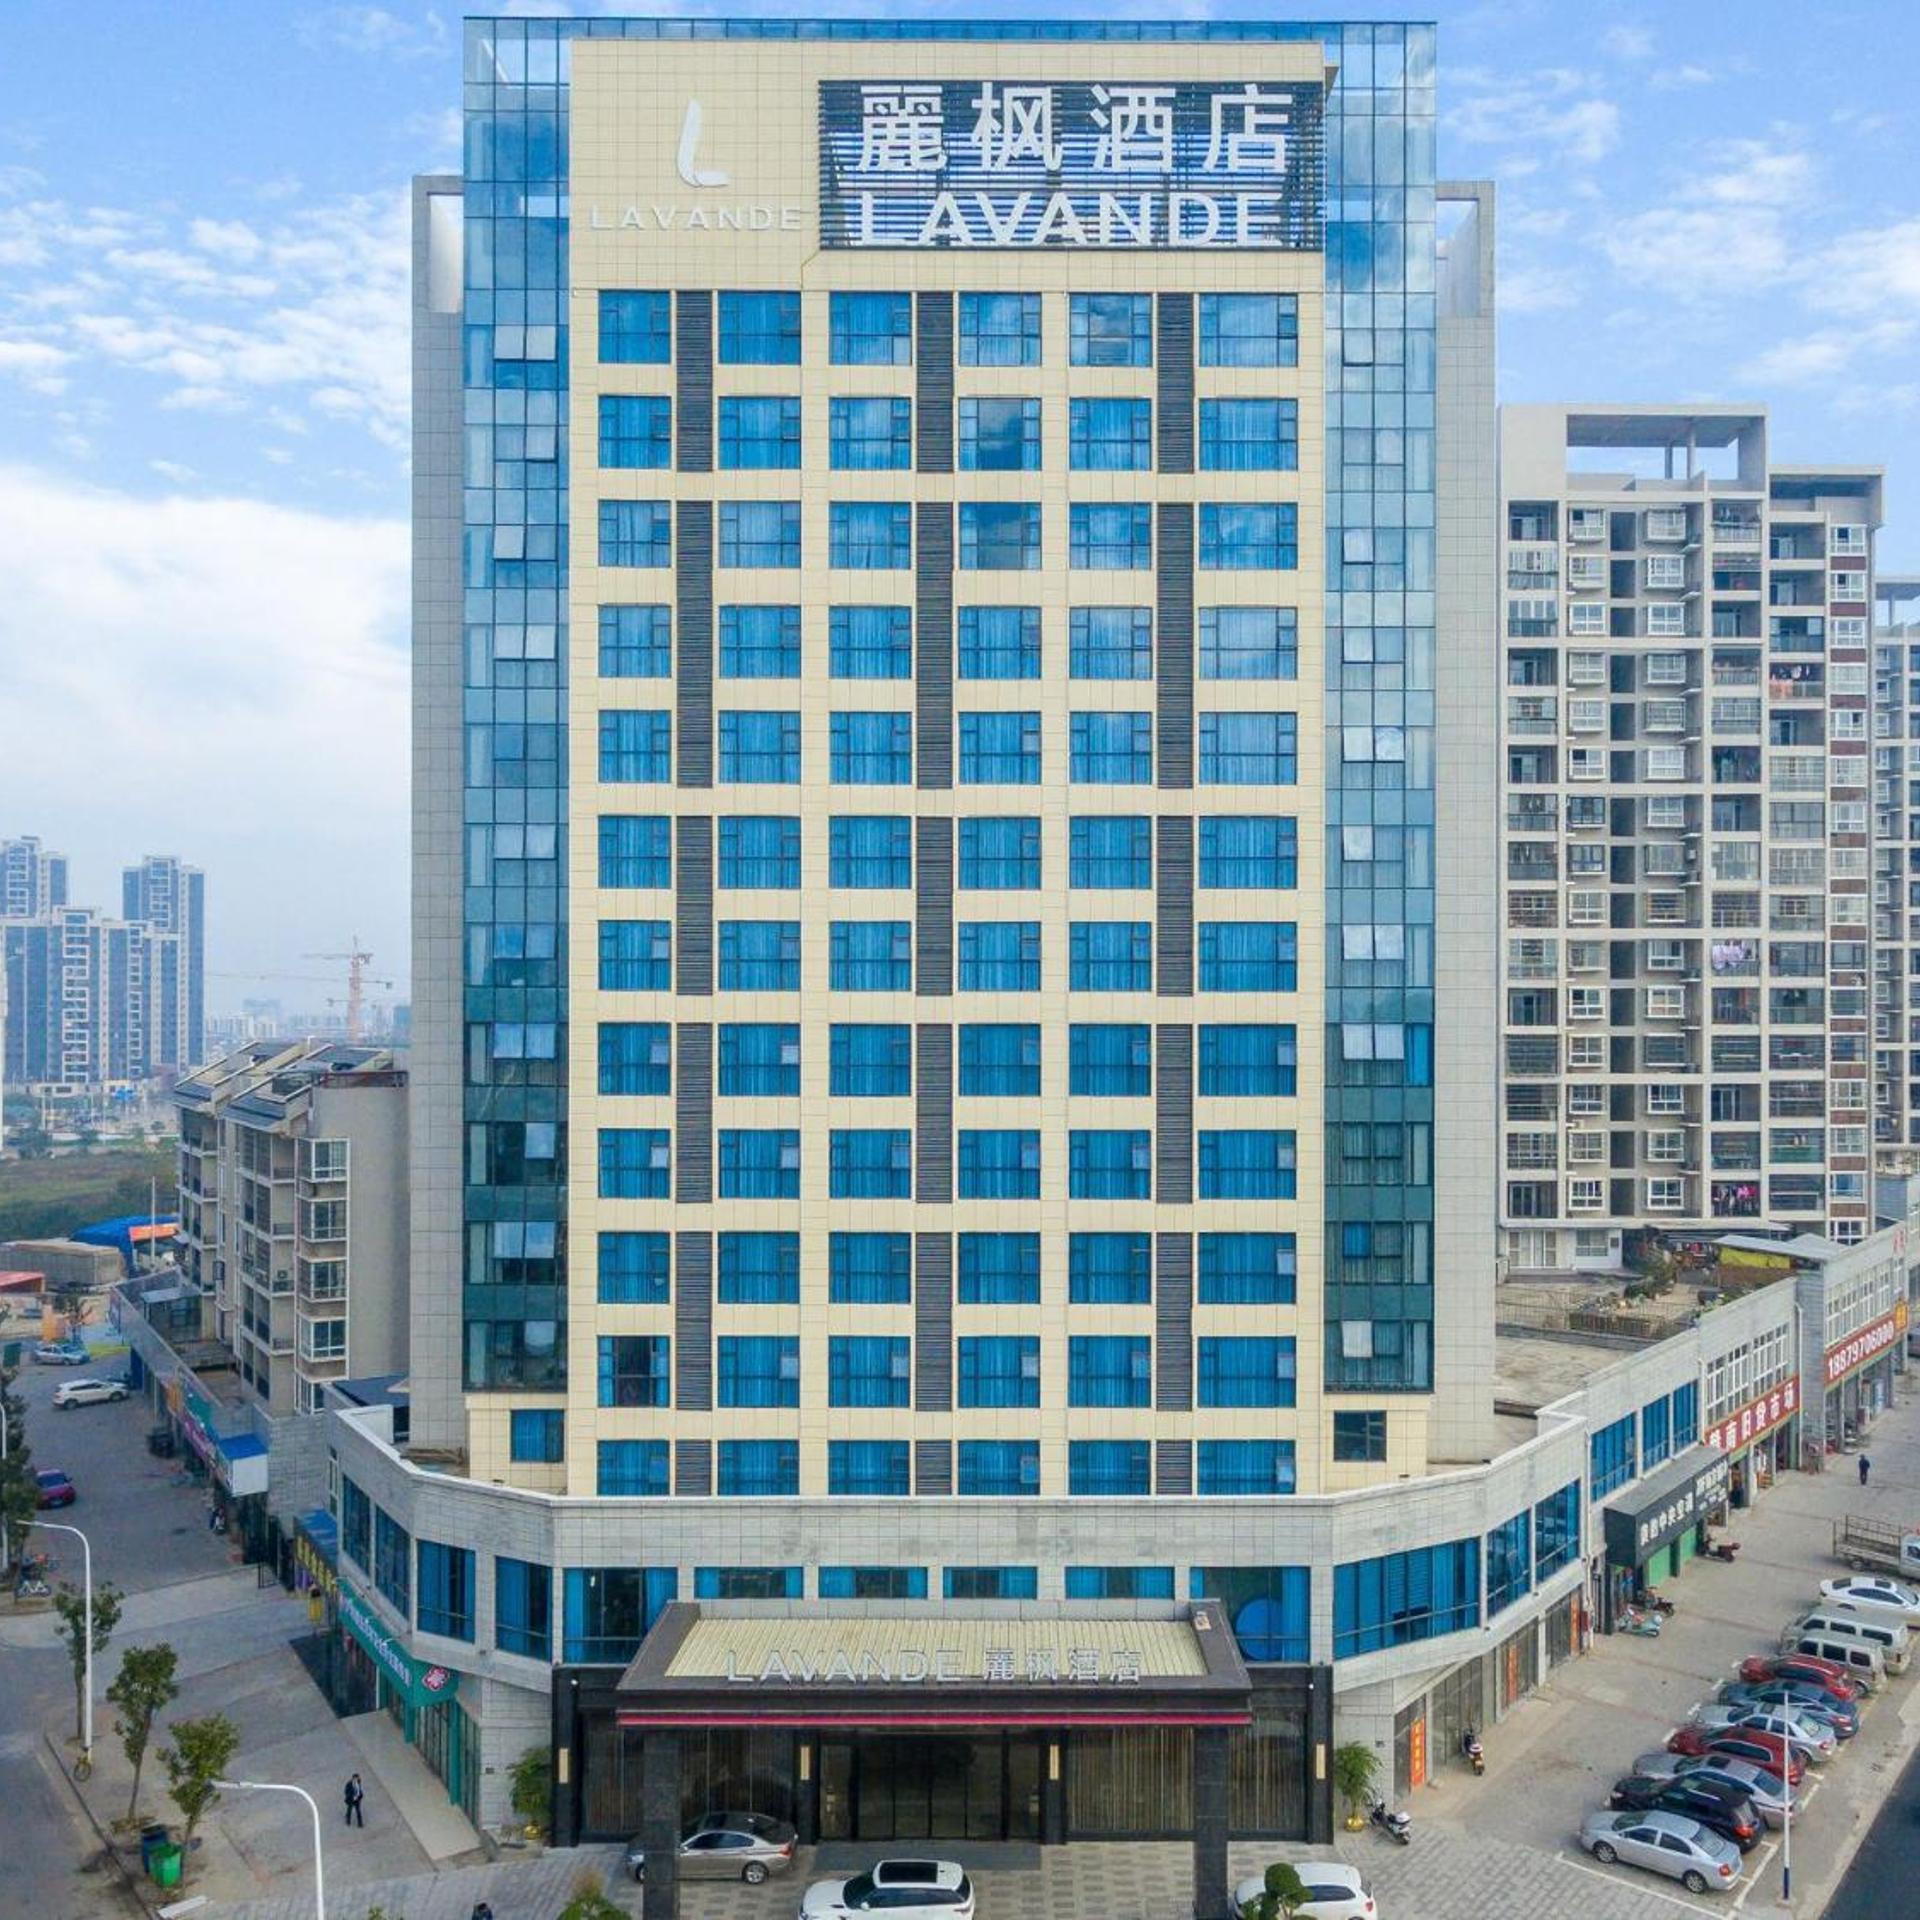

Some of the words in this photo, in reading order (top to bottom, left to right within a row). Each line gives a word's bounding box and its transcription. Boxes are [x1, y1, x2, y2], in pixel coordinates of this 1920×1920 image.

[590, 206, 802, 231] LAVANDE
[858, 191, 1285, 248] LAVANDE
[726, 1649, 962, 1682] LAVANDE
